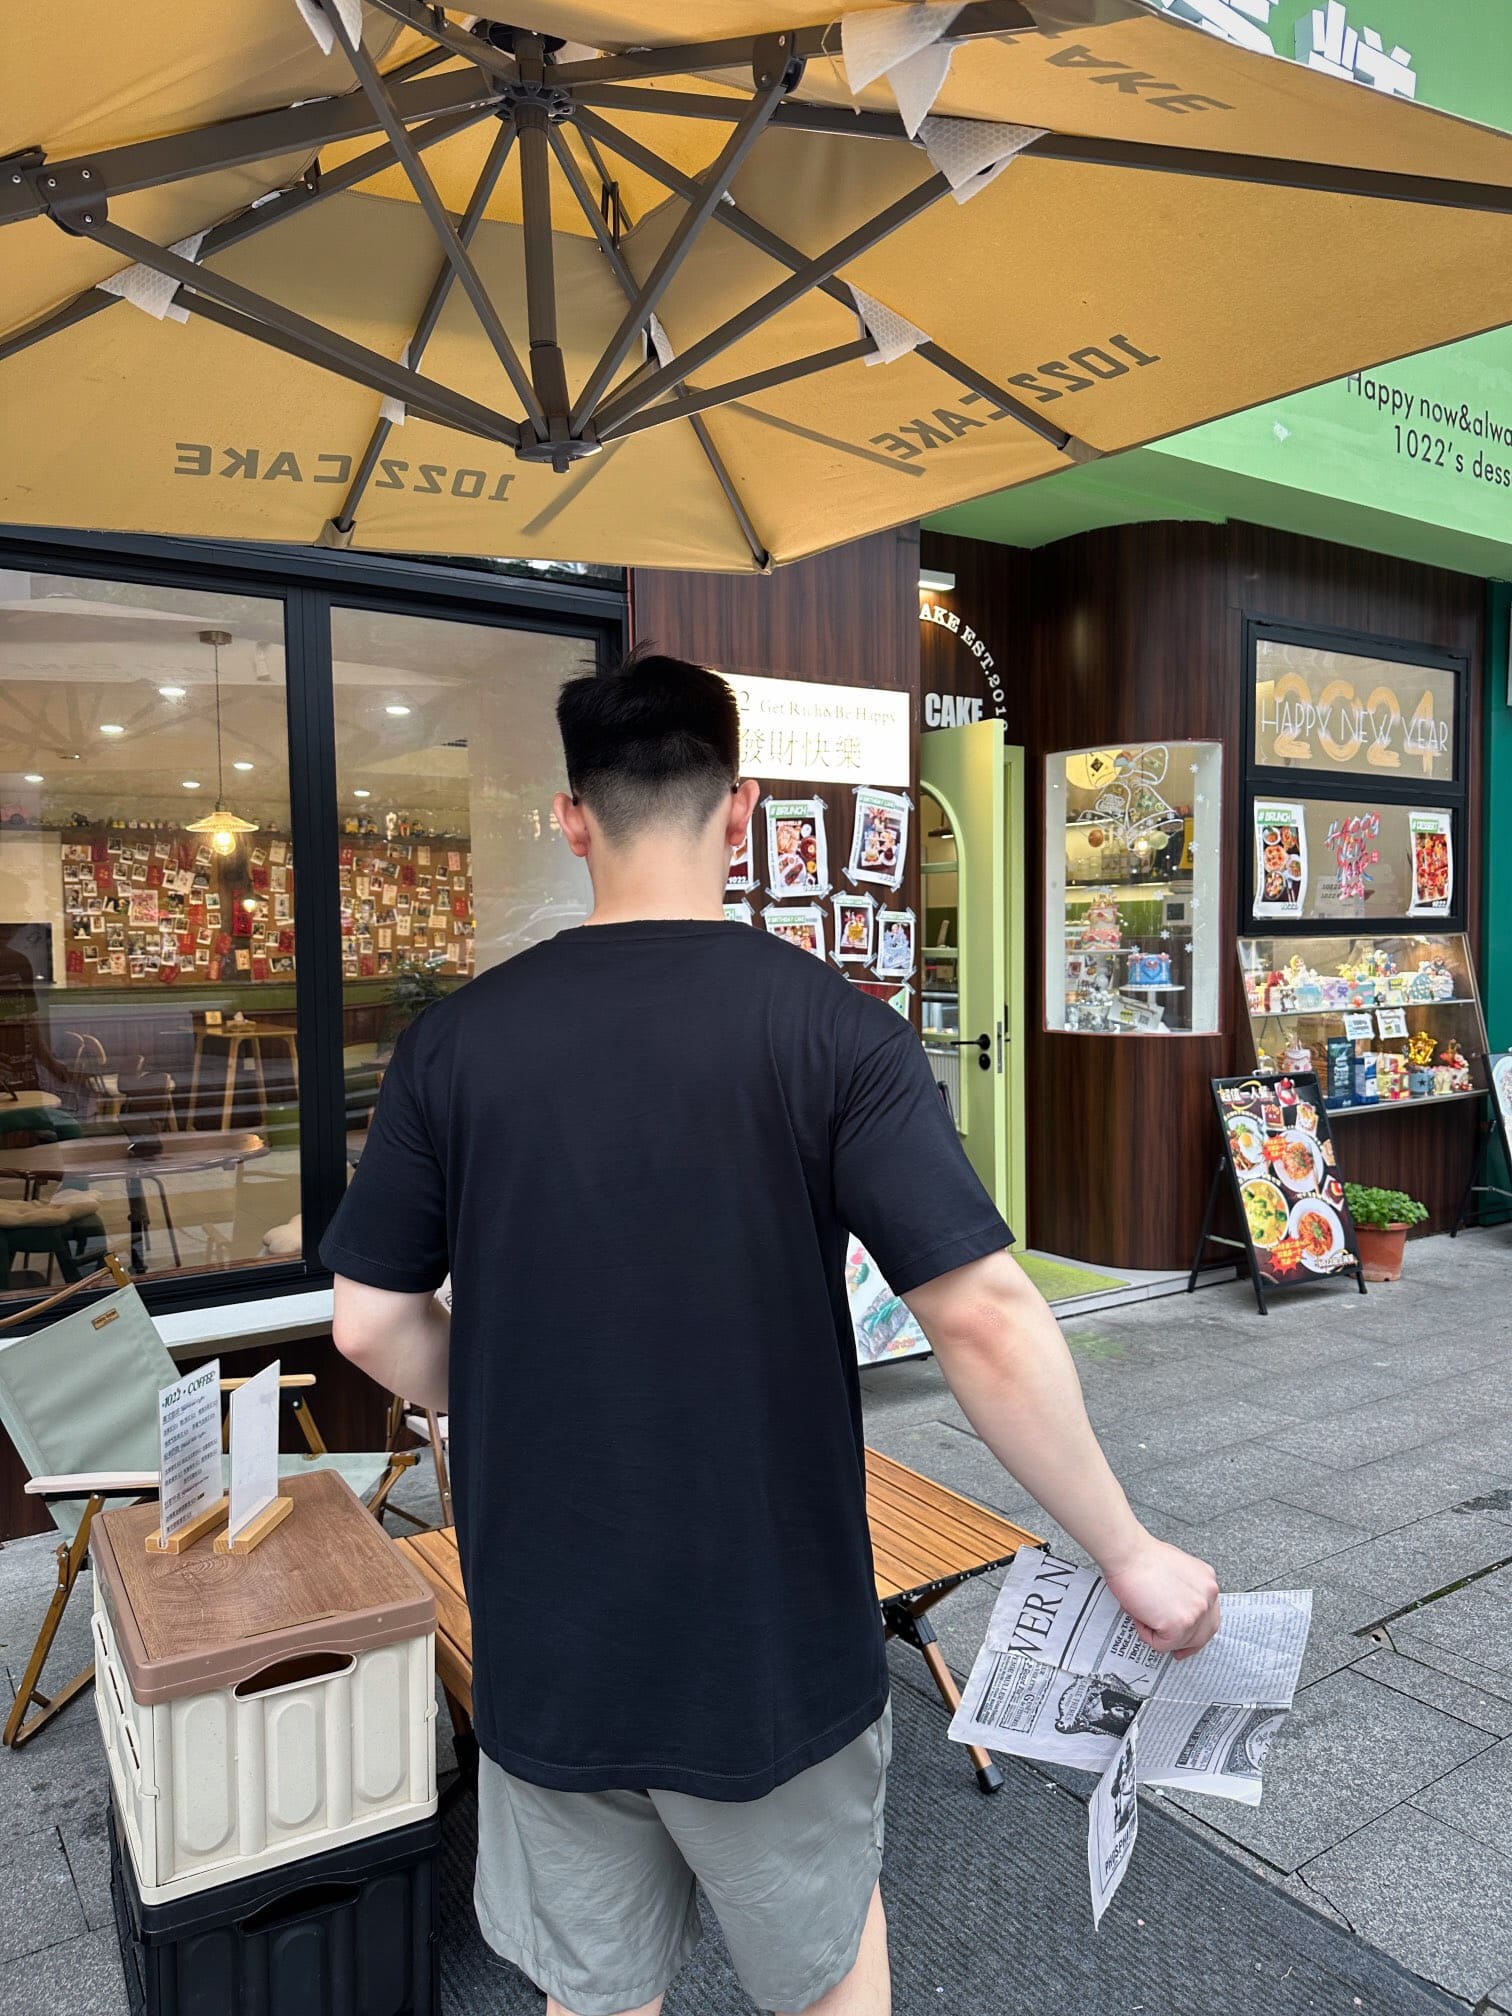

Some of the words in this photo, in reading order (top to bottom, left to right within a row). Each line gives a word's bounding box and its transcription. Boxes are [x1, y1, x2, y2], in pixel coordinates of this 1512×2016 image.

[1347, 372, 1414, 420] Happy
[1395, 425, 1463, 472] 1022's
[925, 692, 983, 728] CAKE
[1261, 697, 1333, 738] HAPPY
[1341, 706, 1394, 744] NEW
[1401, 716, 1449, 752] YEAR
[188, 1370, 216, 1395] COFFEE
